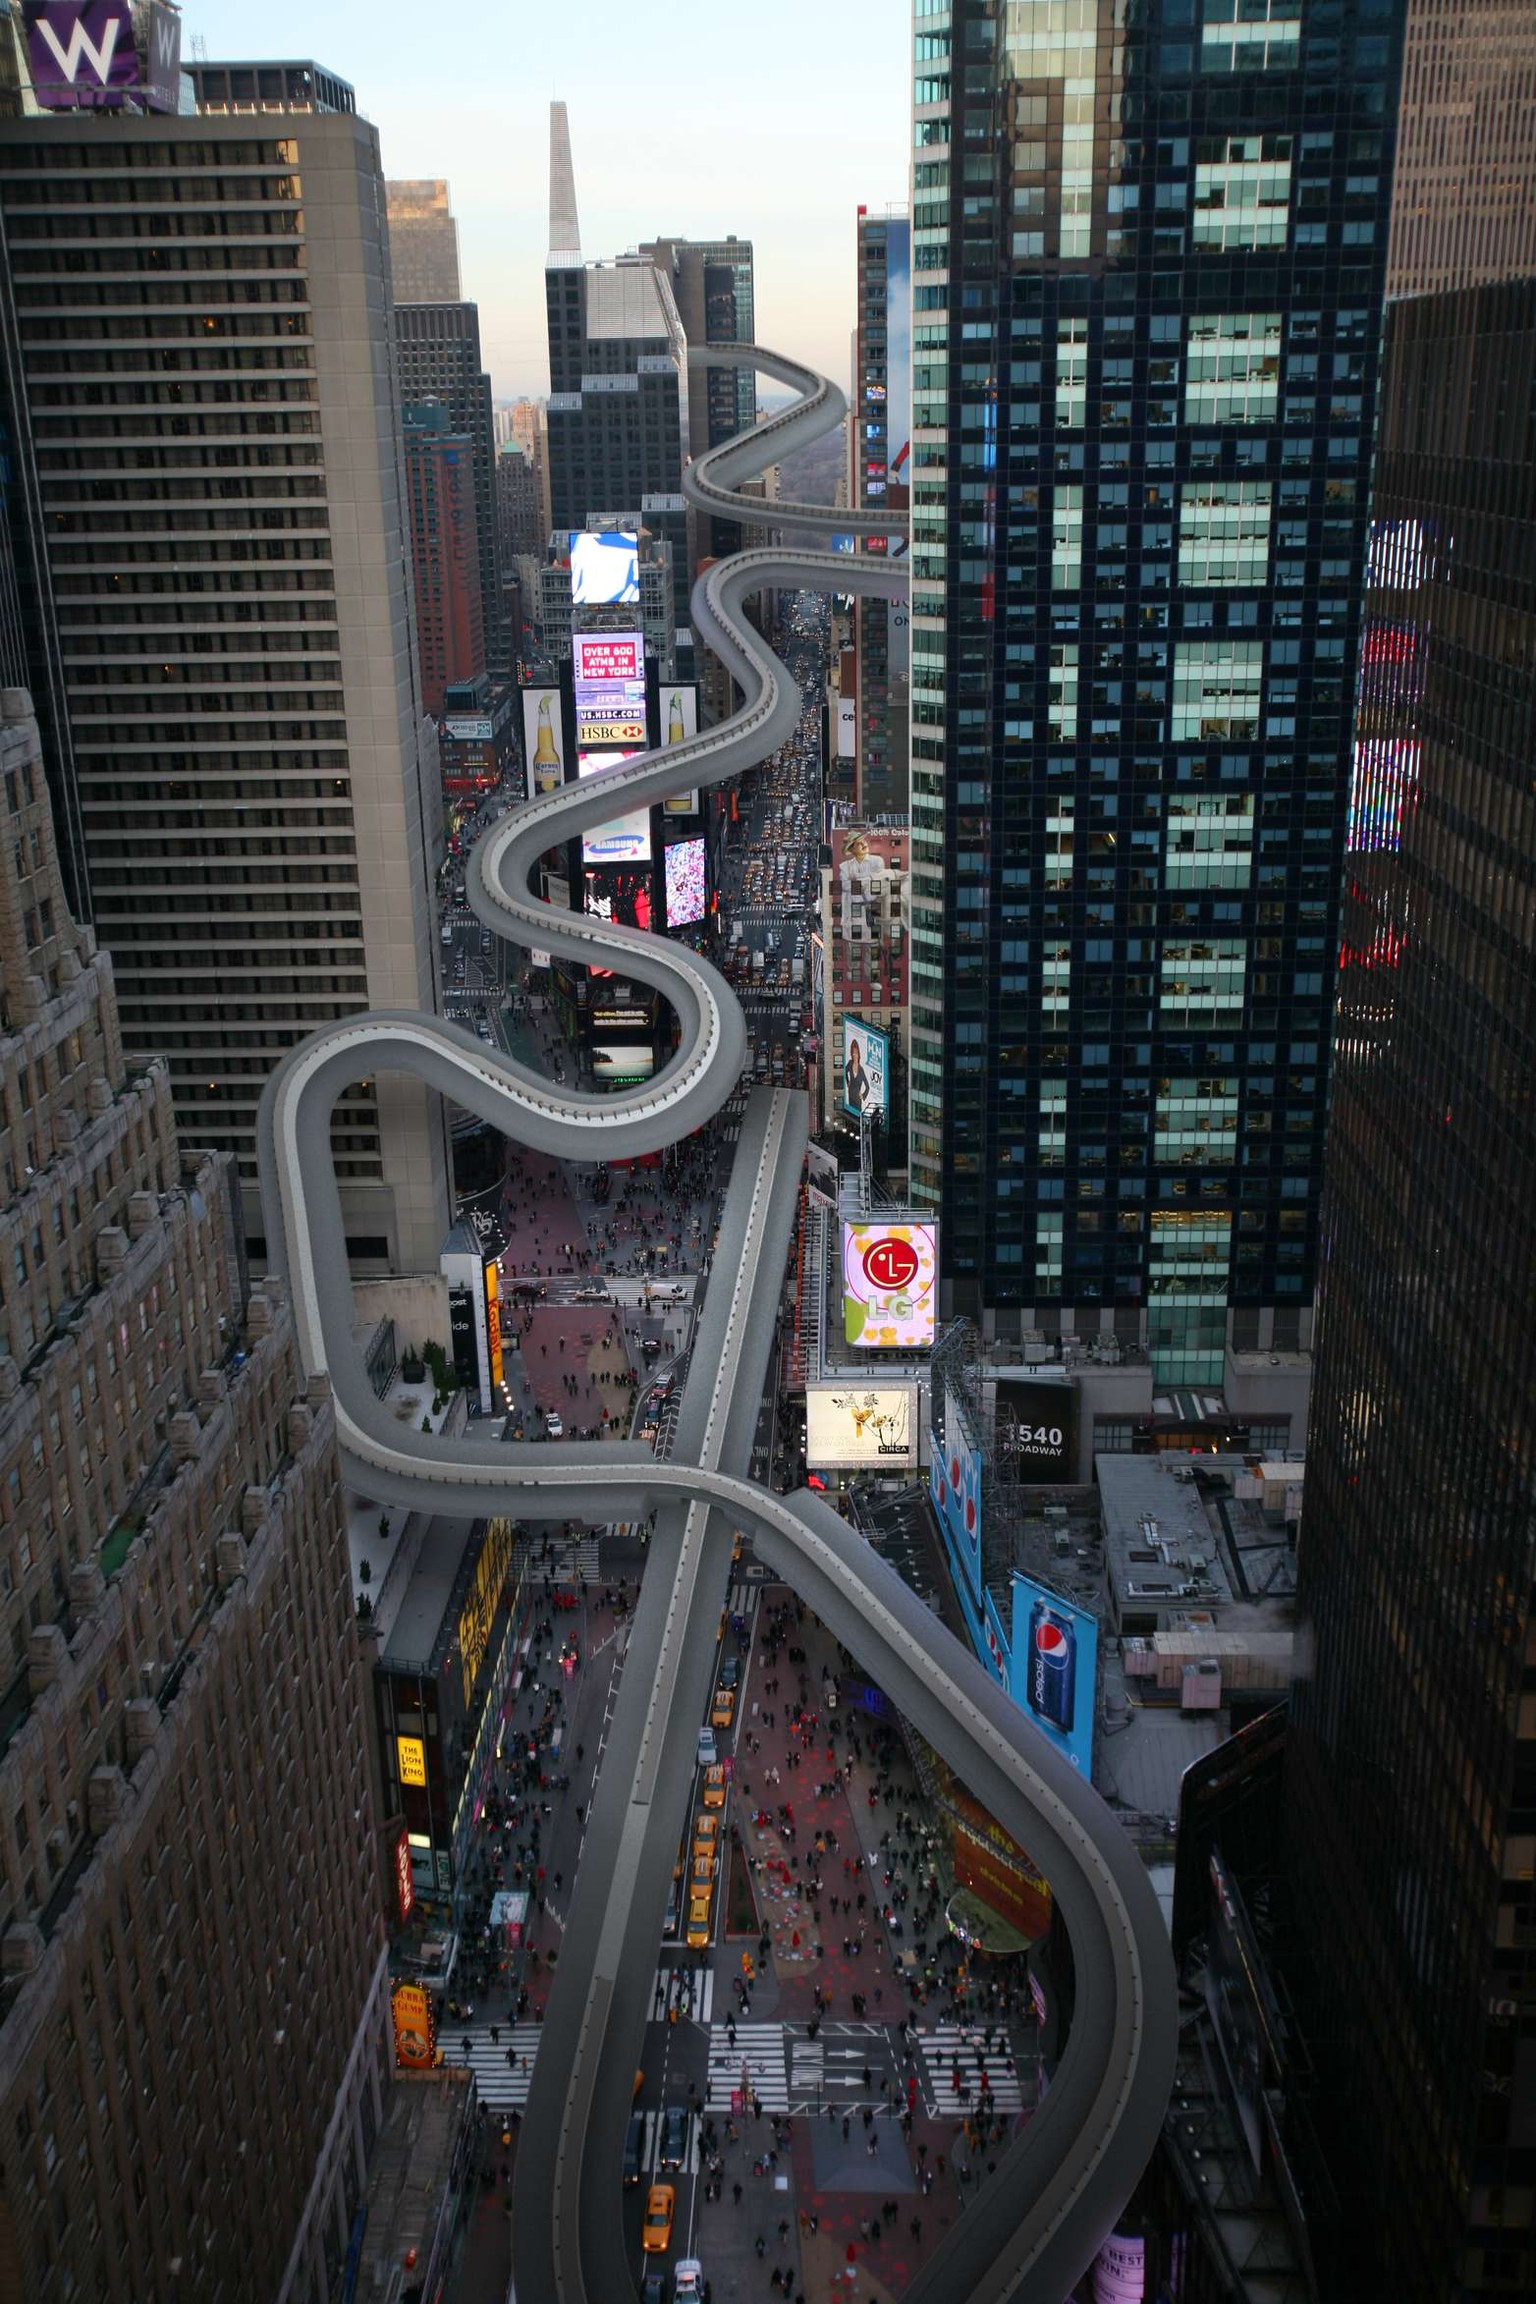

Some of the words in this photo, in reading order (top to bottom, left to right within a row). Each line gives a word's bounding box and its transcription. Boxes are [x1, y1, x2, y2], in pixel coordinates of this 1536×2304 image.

[156, 17, 176, 70] W
[35, 17, 120, 86] W
[583, 646, 611, 657] OVER
[613, 646, 633, 656] 600
[618, 657, 629, 666] IN
[584, 667, 606, 677] NEW
[608, 667, 635, 676] YORK
[581, 710, 640, 719] US.HSBC.COM
[581, 726, 621, 739] HSBC
[868, 1295, 914, 1321] LG
[487, 1297, 501, 1357] Kodak
[1035, 1658, 1045, 1704] pepsi
[404, 1746, 418, 1754] THE
[401, 1754, 421, 1766] LION
[402, 1767, 423, 1777] KING
[792, 2042, 824, 2065] ONLY
